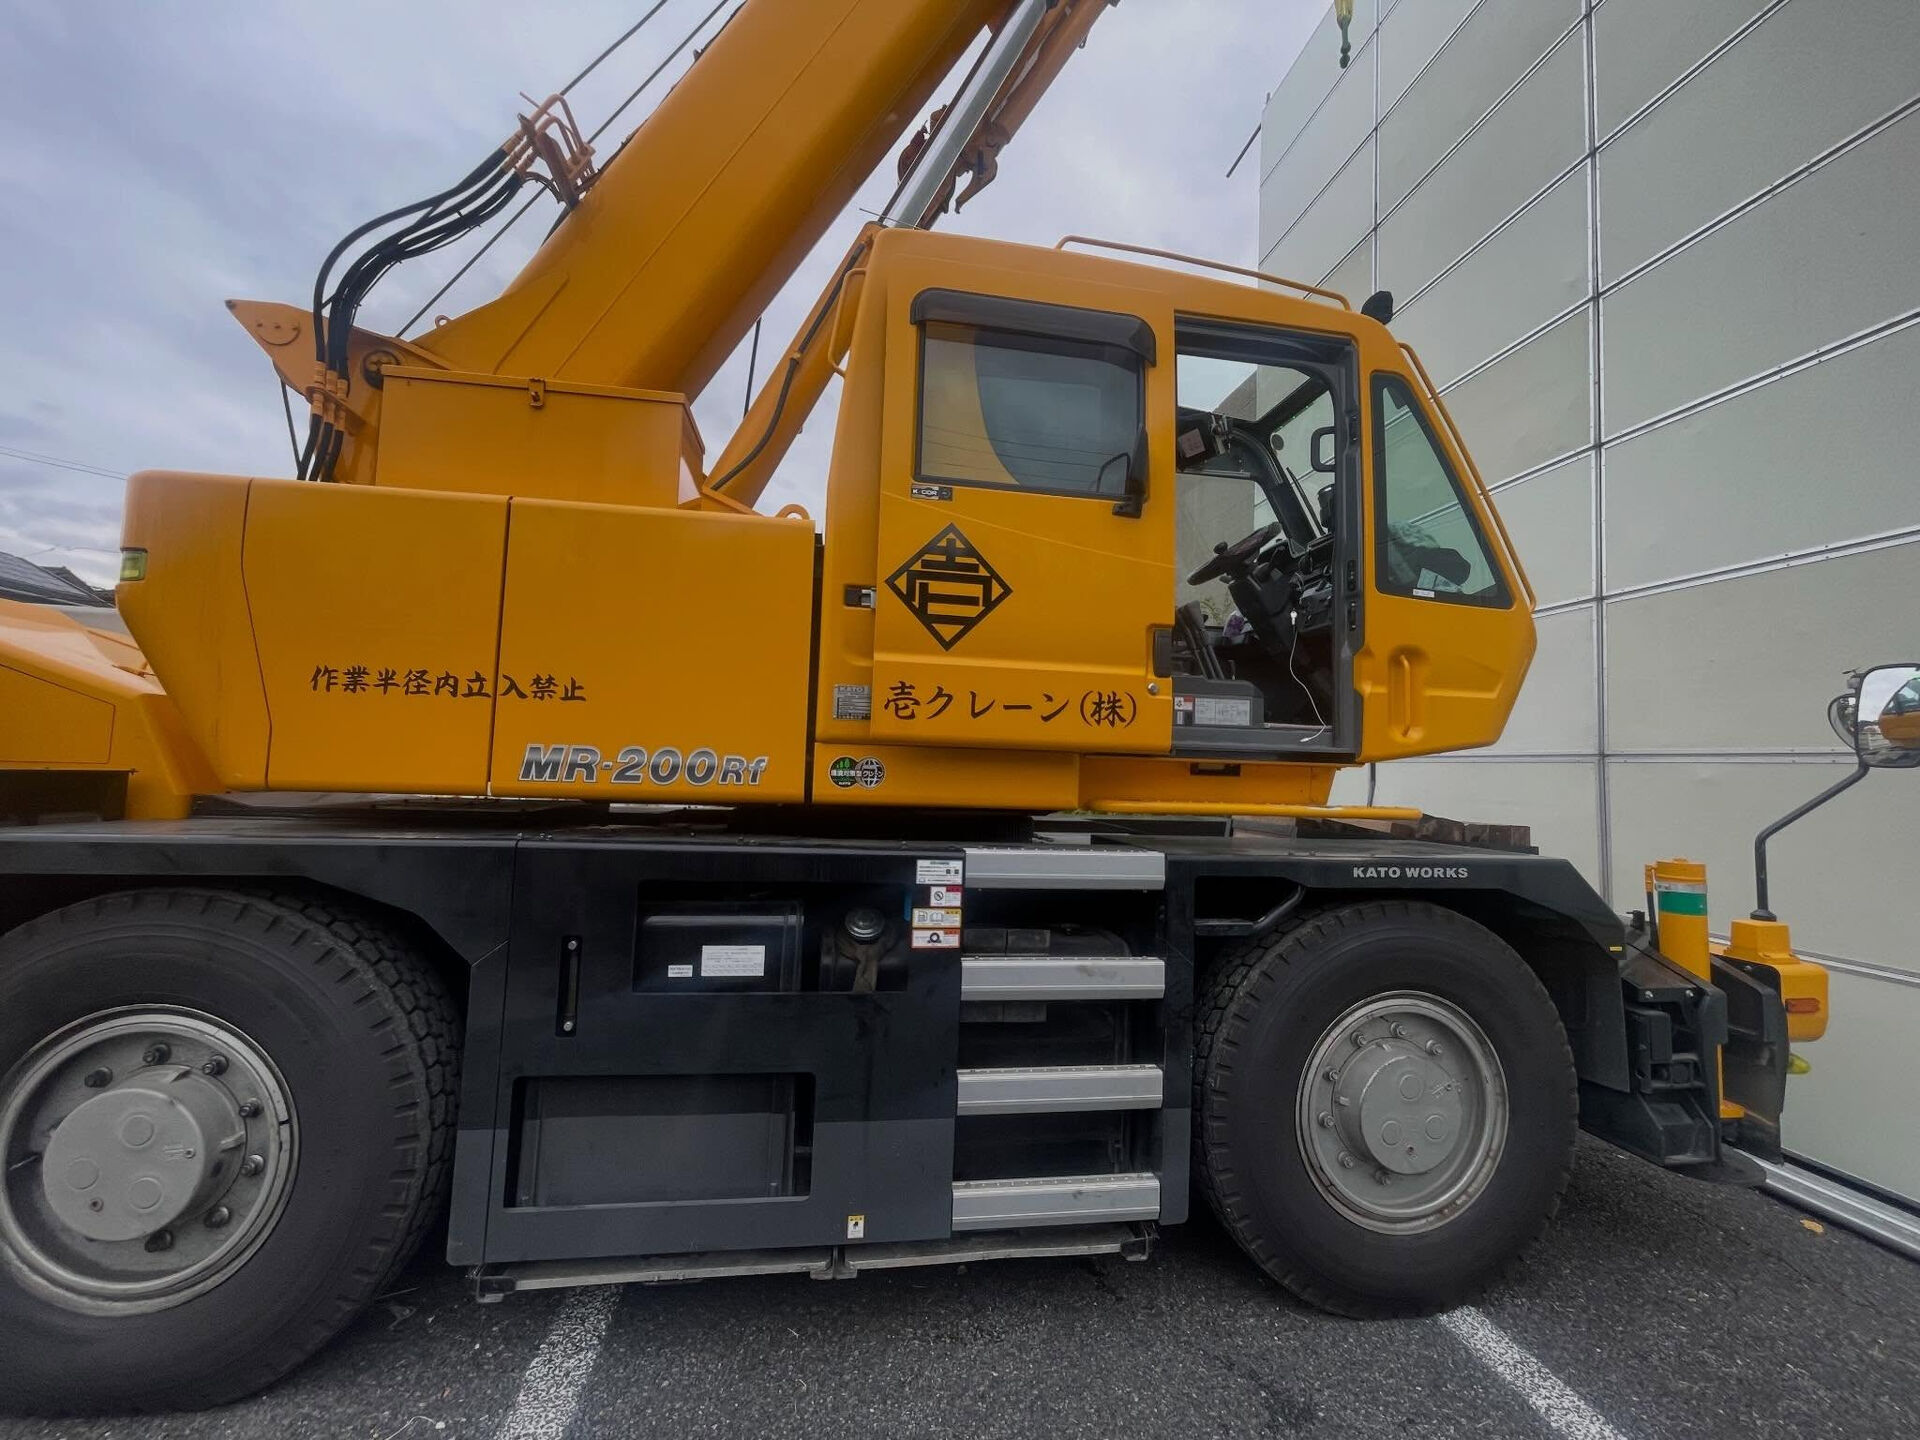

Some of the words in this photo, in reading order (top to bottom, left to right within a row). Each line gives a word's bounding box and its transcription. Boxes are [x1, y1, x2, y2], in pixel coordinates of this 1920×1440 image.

[310, 664, 586, 701] 作業半径内立入禁止
[1353, 866, 1401, 878] KATO
[1405, 867, 1468, 879] WORKS
